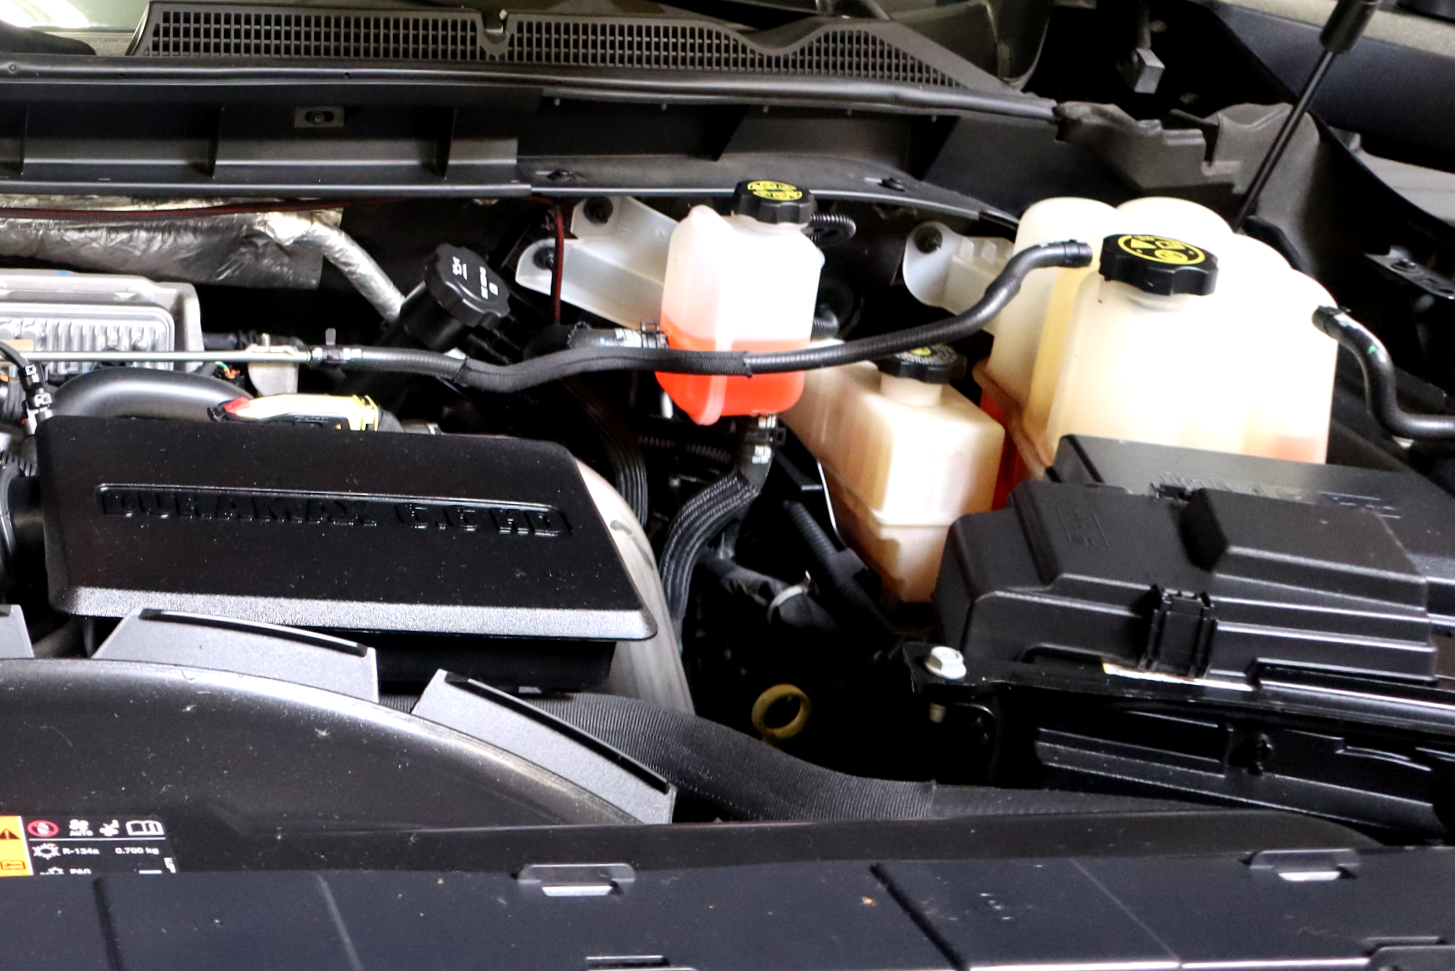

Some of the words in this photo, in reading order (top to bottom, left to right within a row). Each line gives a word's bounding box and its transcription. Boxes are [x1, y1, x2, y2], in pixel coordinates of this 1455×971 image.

[100, 489, 379, 527] DURAMAX
[394, 503, 480, 532] 6.6
[488, 508, 572, 537] HD
[69, 829, 94, 837] AUTO
[62, 847, 100, 855] R-134a
[114, 847, 144, 855] 0.700
[145, 846, 160, 855] kg
